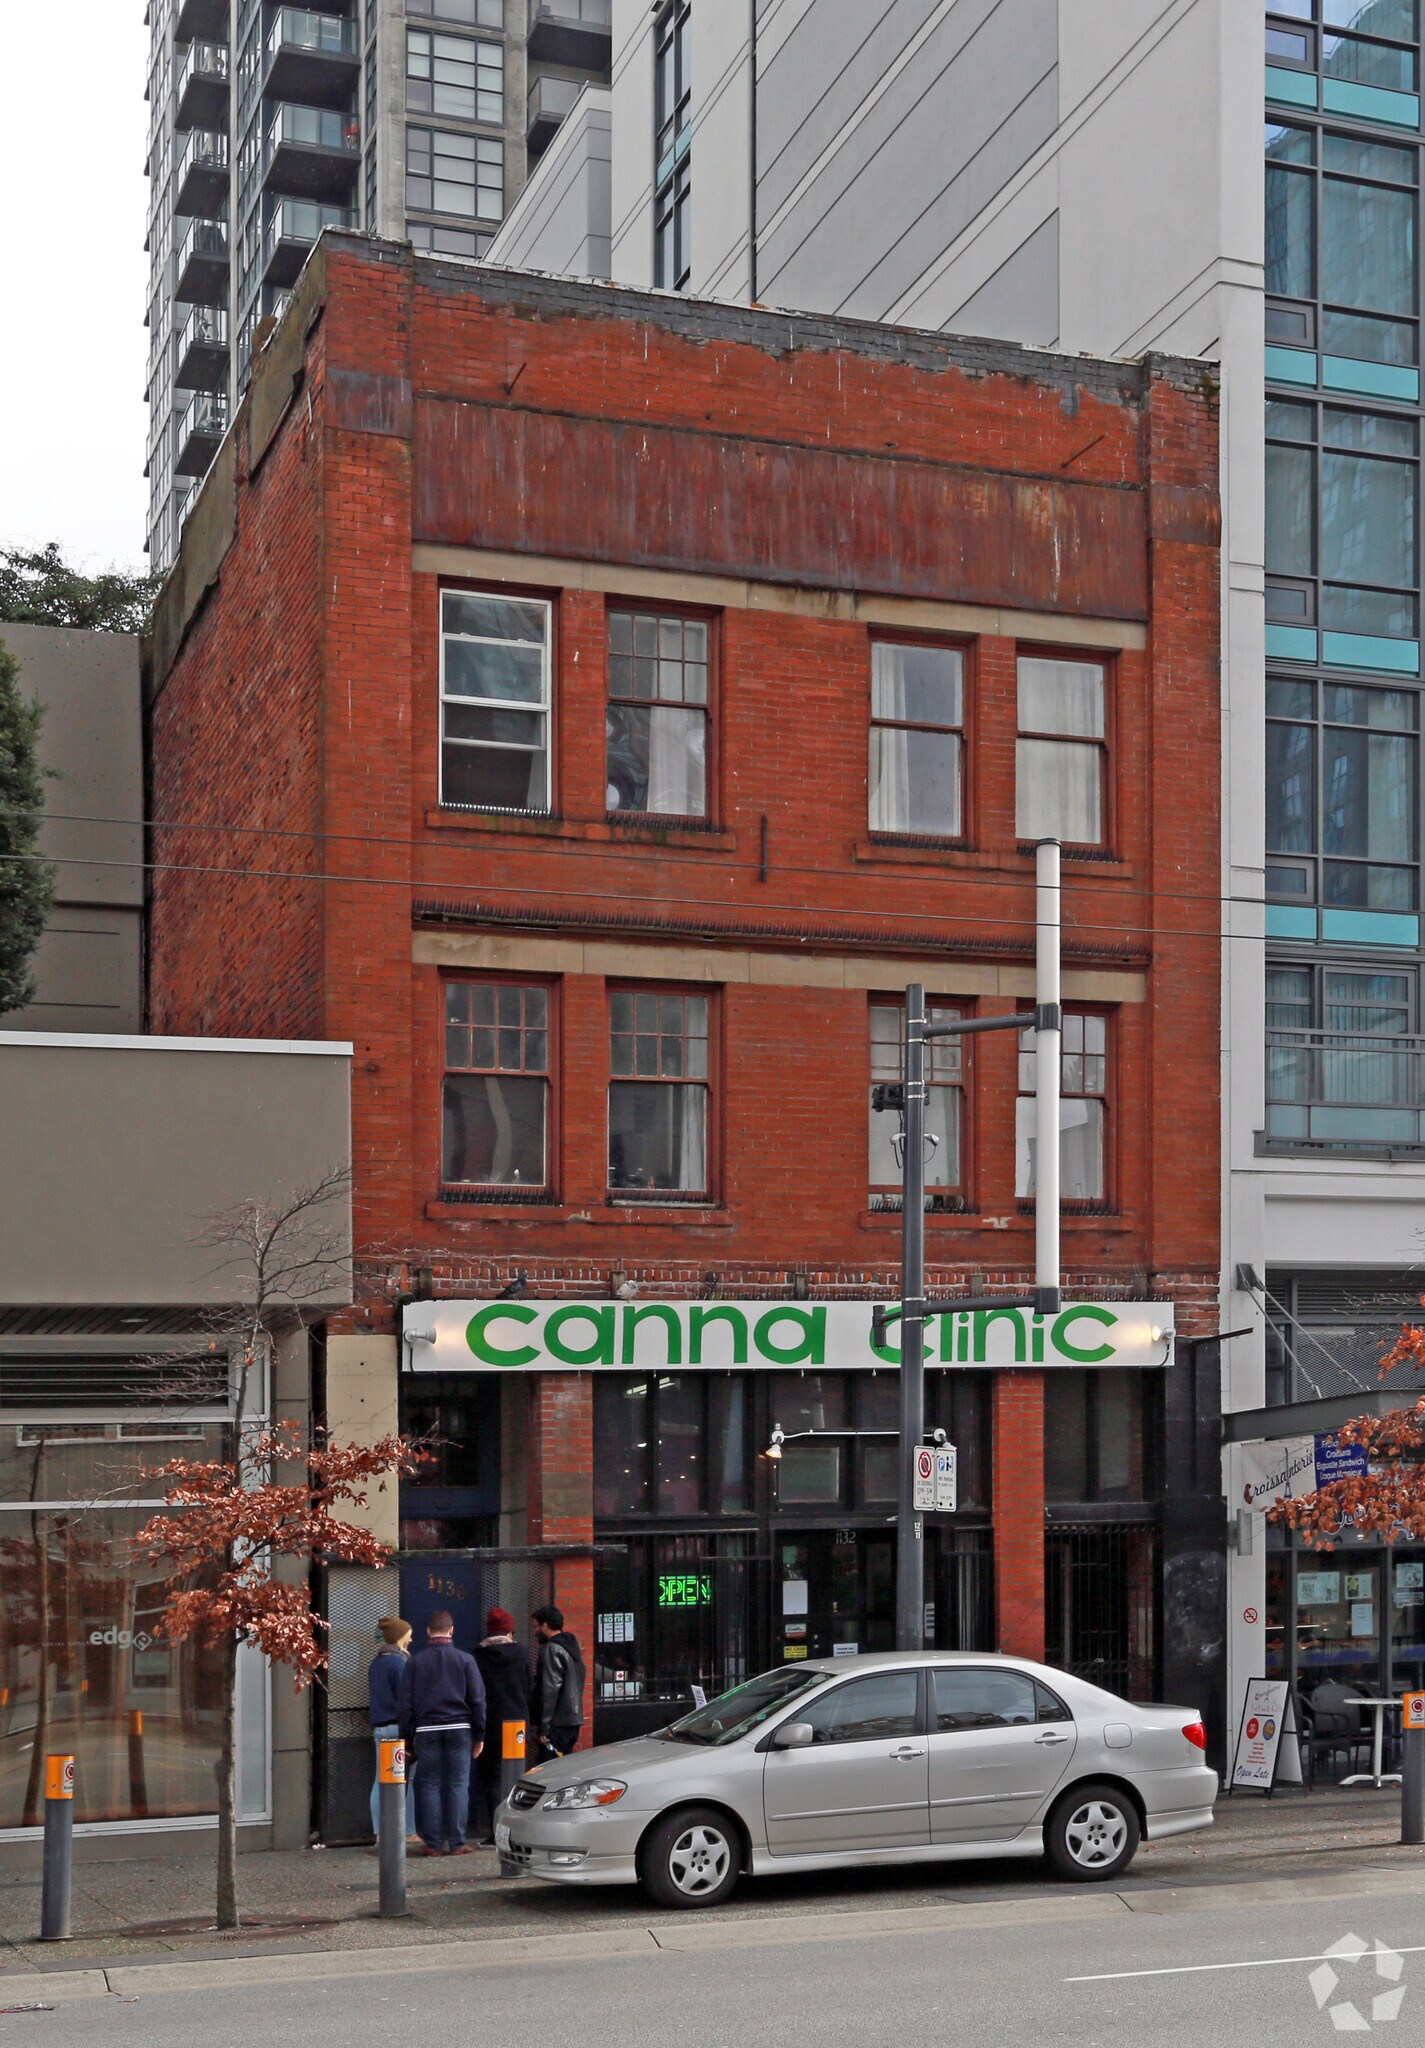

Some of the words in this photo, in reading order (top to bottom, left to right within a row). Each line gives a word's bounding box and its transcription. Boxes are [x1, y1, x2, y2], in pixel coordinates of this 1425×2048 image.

[465, 1303, 826, 1366] canna
[869, 1304, 1117, 1364] clinic
[1339, 1457, 1365, 1467] Sandwich
[1243, 1448, 1314, 1504] Croissanterie
[836, 1530, 856, 1544] 1132
[1236, 1765, 1252, 1779] Open
